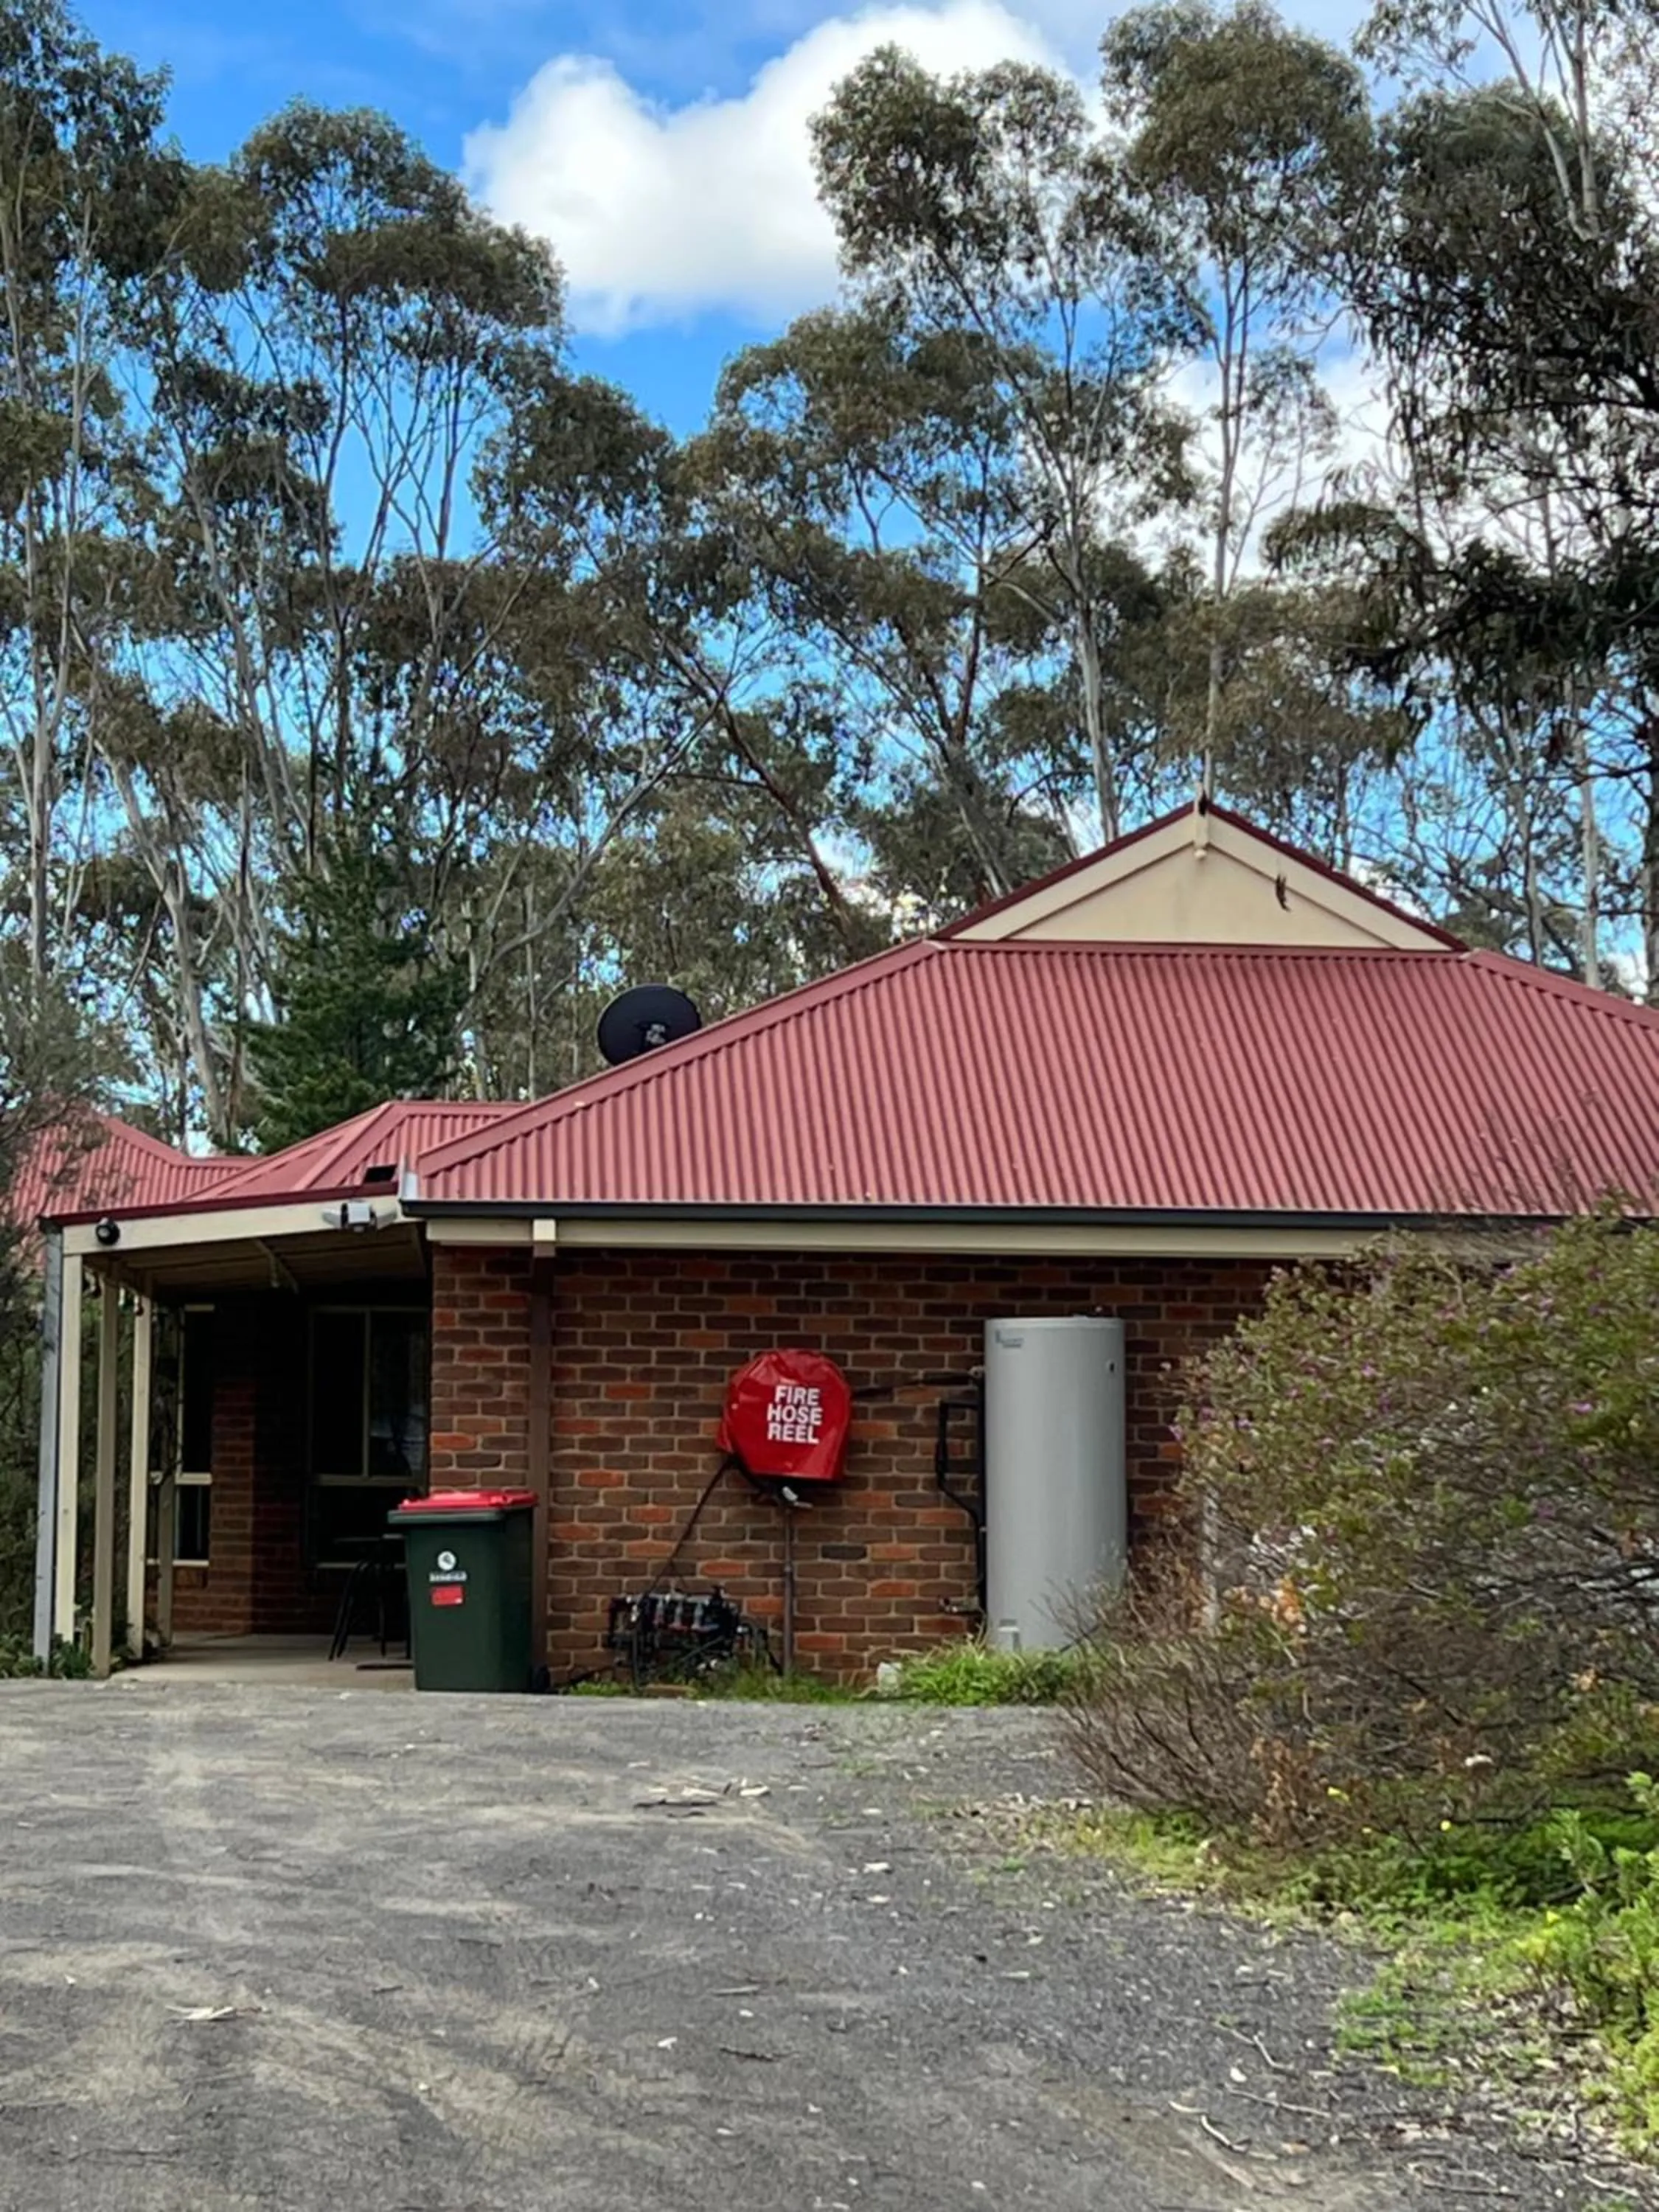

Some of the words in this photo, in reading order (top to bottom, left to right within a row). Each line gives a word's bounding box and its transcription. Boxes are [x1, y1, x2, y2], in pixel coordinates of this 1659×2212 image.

[775, 1385, 821, 1405] FIRE
[767, 1402, 823, 1425] HOSE
[768, 1422, 819, 1444] REEL
